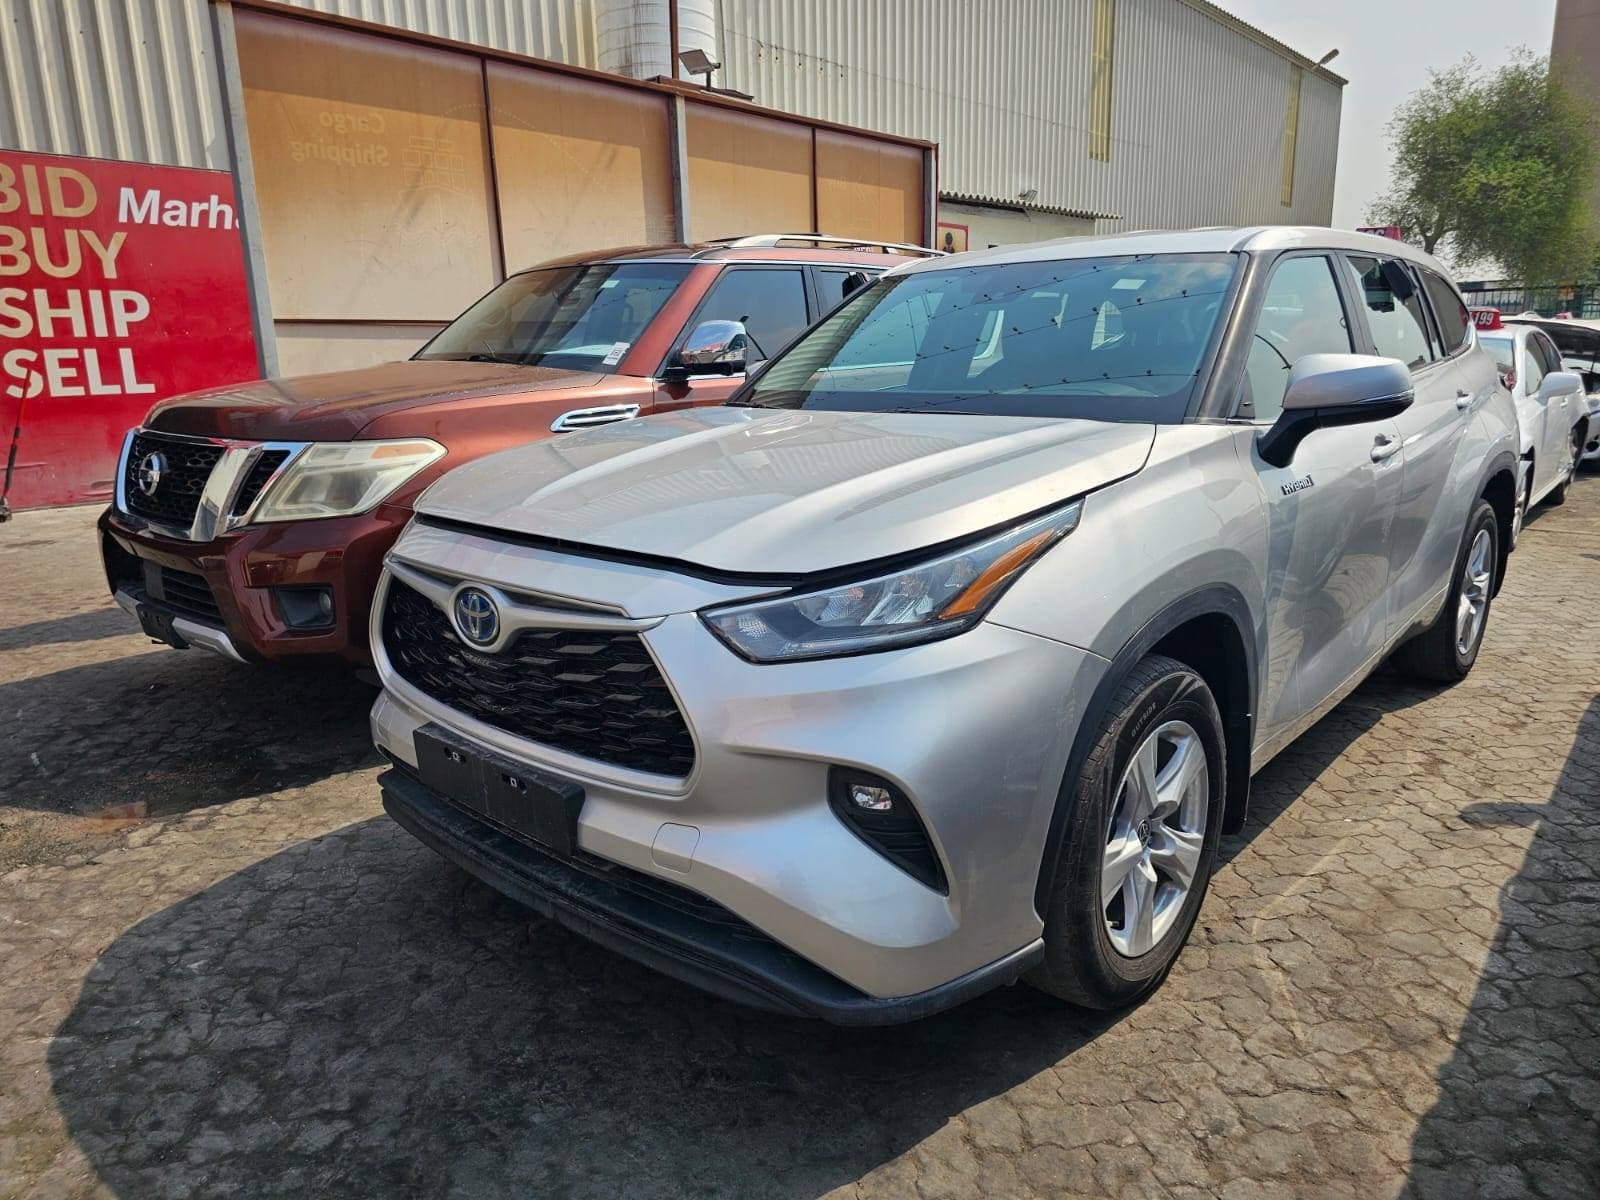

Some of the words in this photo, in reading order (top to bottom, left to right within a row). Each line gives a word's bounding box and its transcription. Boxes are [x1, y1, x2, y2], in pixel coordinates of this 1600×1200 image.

[0, 162, 97, 218] BID
[118, 186, 239, 230] Marh
[0, 225, 128, 279] BUY
[0, 287, 150, 338] SHIP
[3, 348, 156, 399] SELL
[1280, 474, 1314, 495] HYBRID
